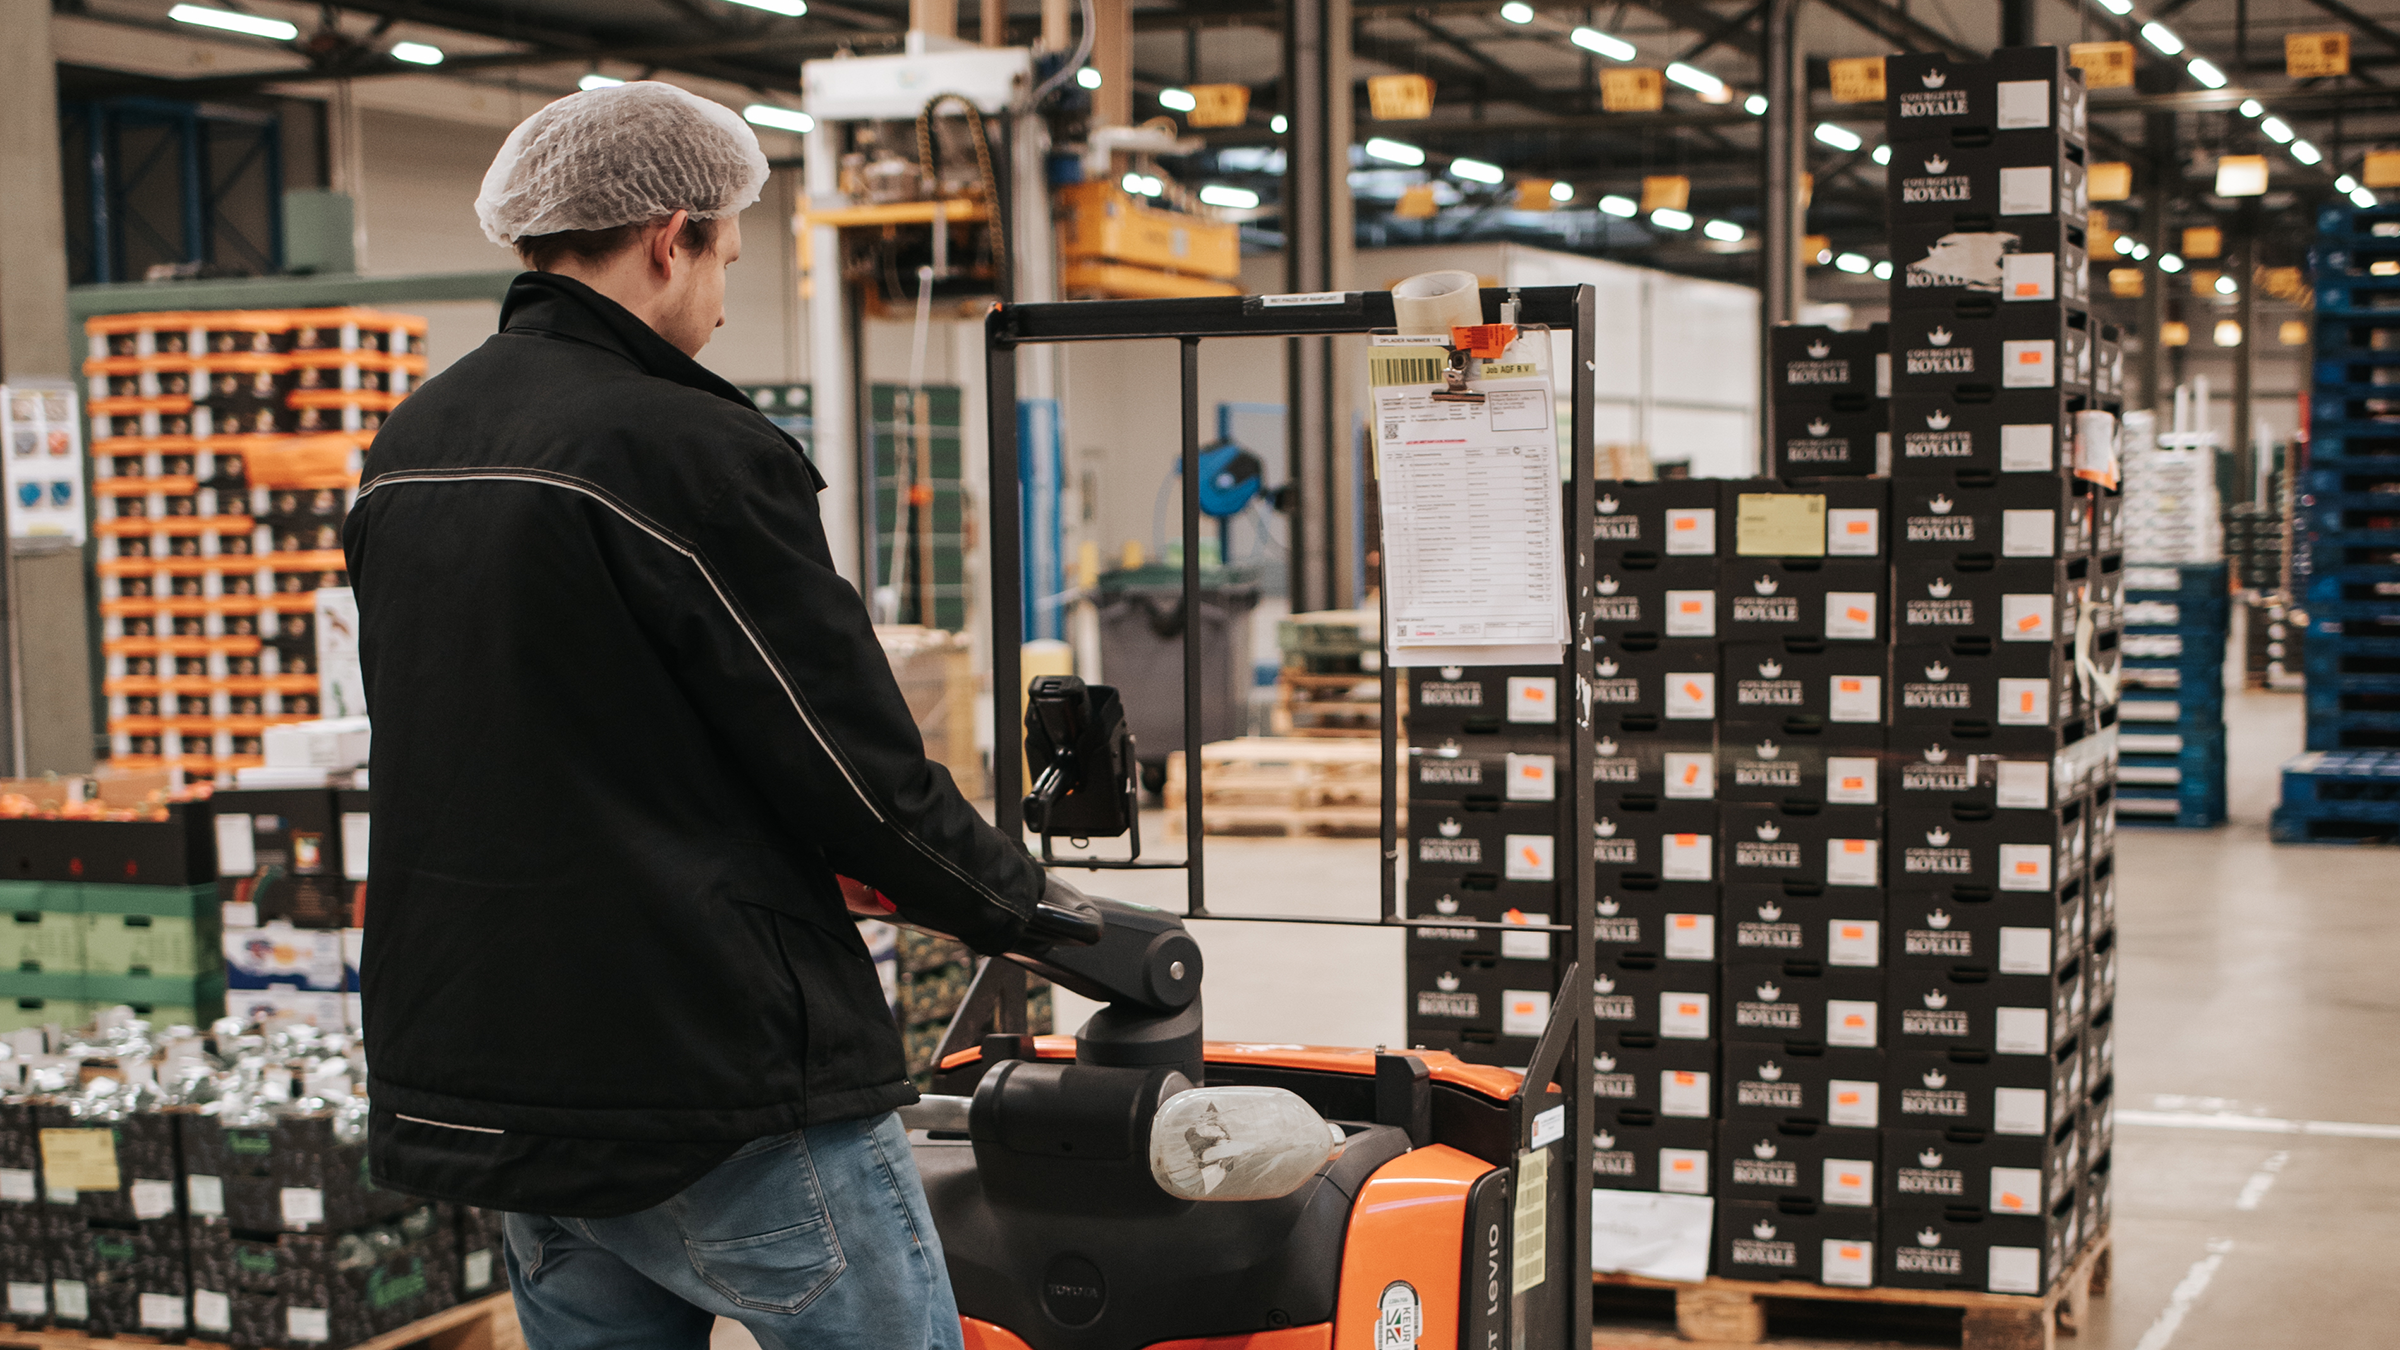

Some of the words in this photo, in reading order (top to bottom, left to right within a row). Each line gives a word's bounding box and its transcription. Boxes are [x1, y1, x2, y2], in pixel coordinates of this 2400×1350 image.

[1900, 99, 1970, 118] ROYALE
[1903, 185, 1972, 203] ROYALE
[1486, 365, 1498, 374] Job
[1500, 365, 1514, 373] AGF
[1906, 356, 1975, 374] ROYALE
[1905, 440, 1973, 457] ROYALE
[1907, 524, 1975, 541] ROYALE
[1734, 604, 1799, 622] ROYALE
[1906, 608, 1974, 625] ROYALE
[1738, 688, 1803, 705] ROYALE
[1904, 691, 1971, 708] ROYALE
[1736, 768, 1801, 786] ROYALE
[1736, 849, 1801, 868] ROYALE
[1905, 855, 1972, 874] ROYALE
[1737, 929, 1803, 949] ROYALE
[1905, 937, 1972, 956] ROYALE
[1736, 1009, 1801, 1029] ROYALE
[1903, 1017, 1969, 1036] ROYALE
[1738, 1088, 1802, 1108] ROYALE
[1902, 1097, 1968, 1117] ROYALE
[1733, 1167, 1797, 1187] ROYALE
[1898, 1175, 1963, 1196] ROYALE
[1732, 1247, 1797, 1267] ROYALE
[1896, 1254, 1962, 1275] ROYALE
[1048, 1283, 1098, 1298] TOYOTA
[1402, 1306, 1412, 1343] KEUR
